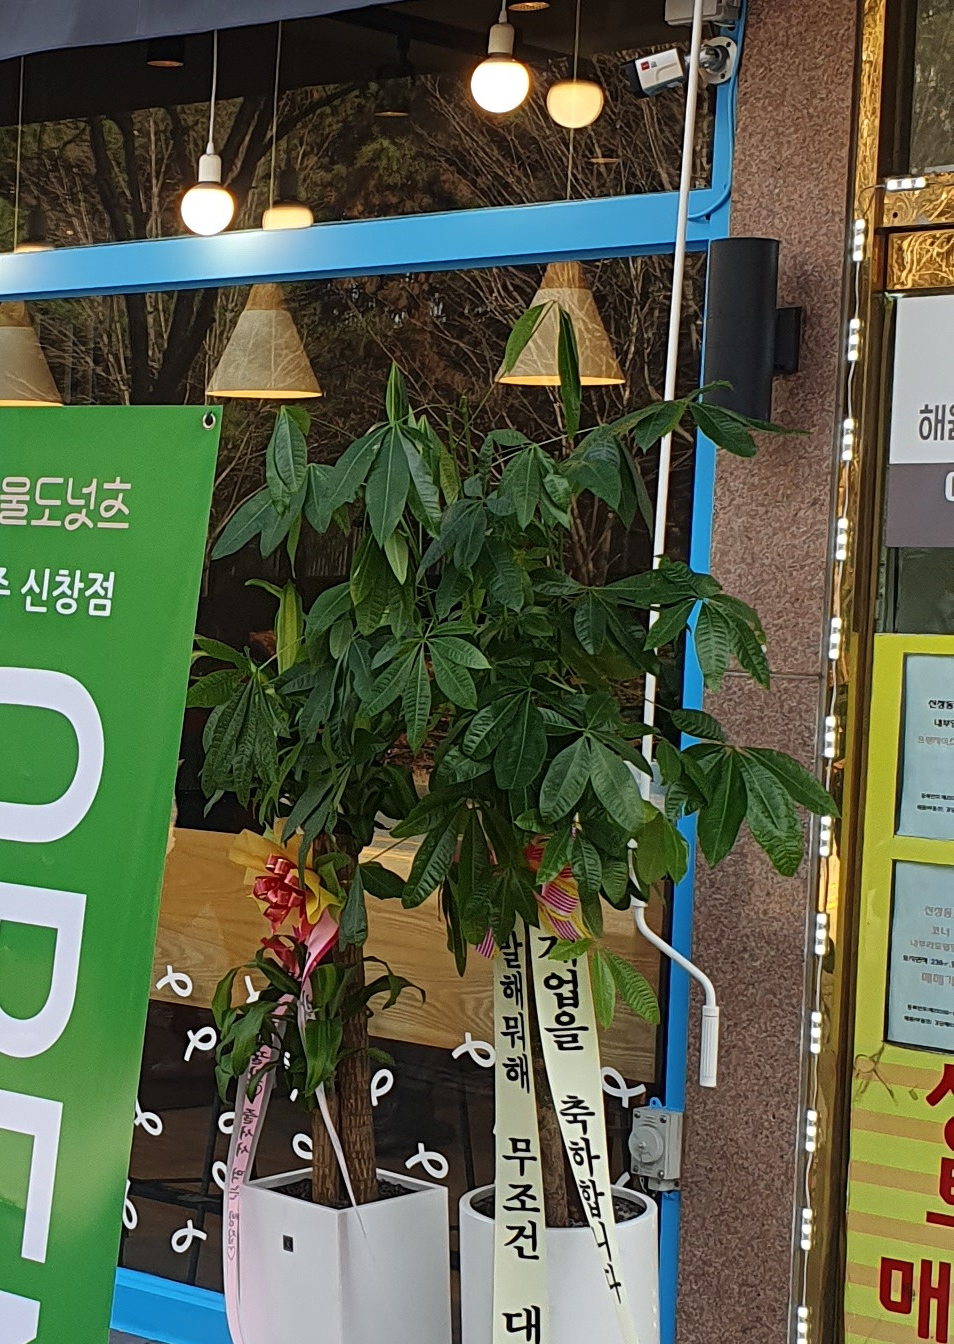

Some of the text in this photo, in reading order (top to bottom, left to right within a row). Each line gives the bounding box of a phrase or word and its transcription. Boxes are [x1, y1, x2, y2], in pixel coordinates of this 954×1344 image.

[20, 568, 116, 617] 신창점
[502, 1136, 541, 1261] 무조건
[560, 1094, 622, 1305] 축하합니다
